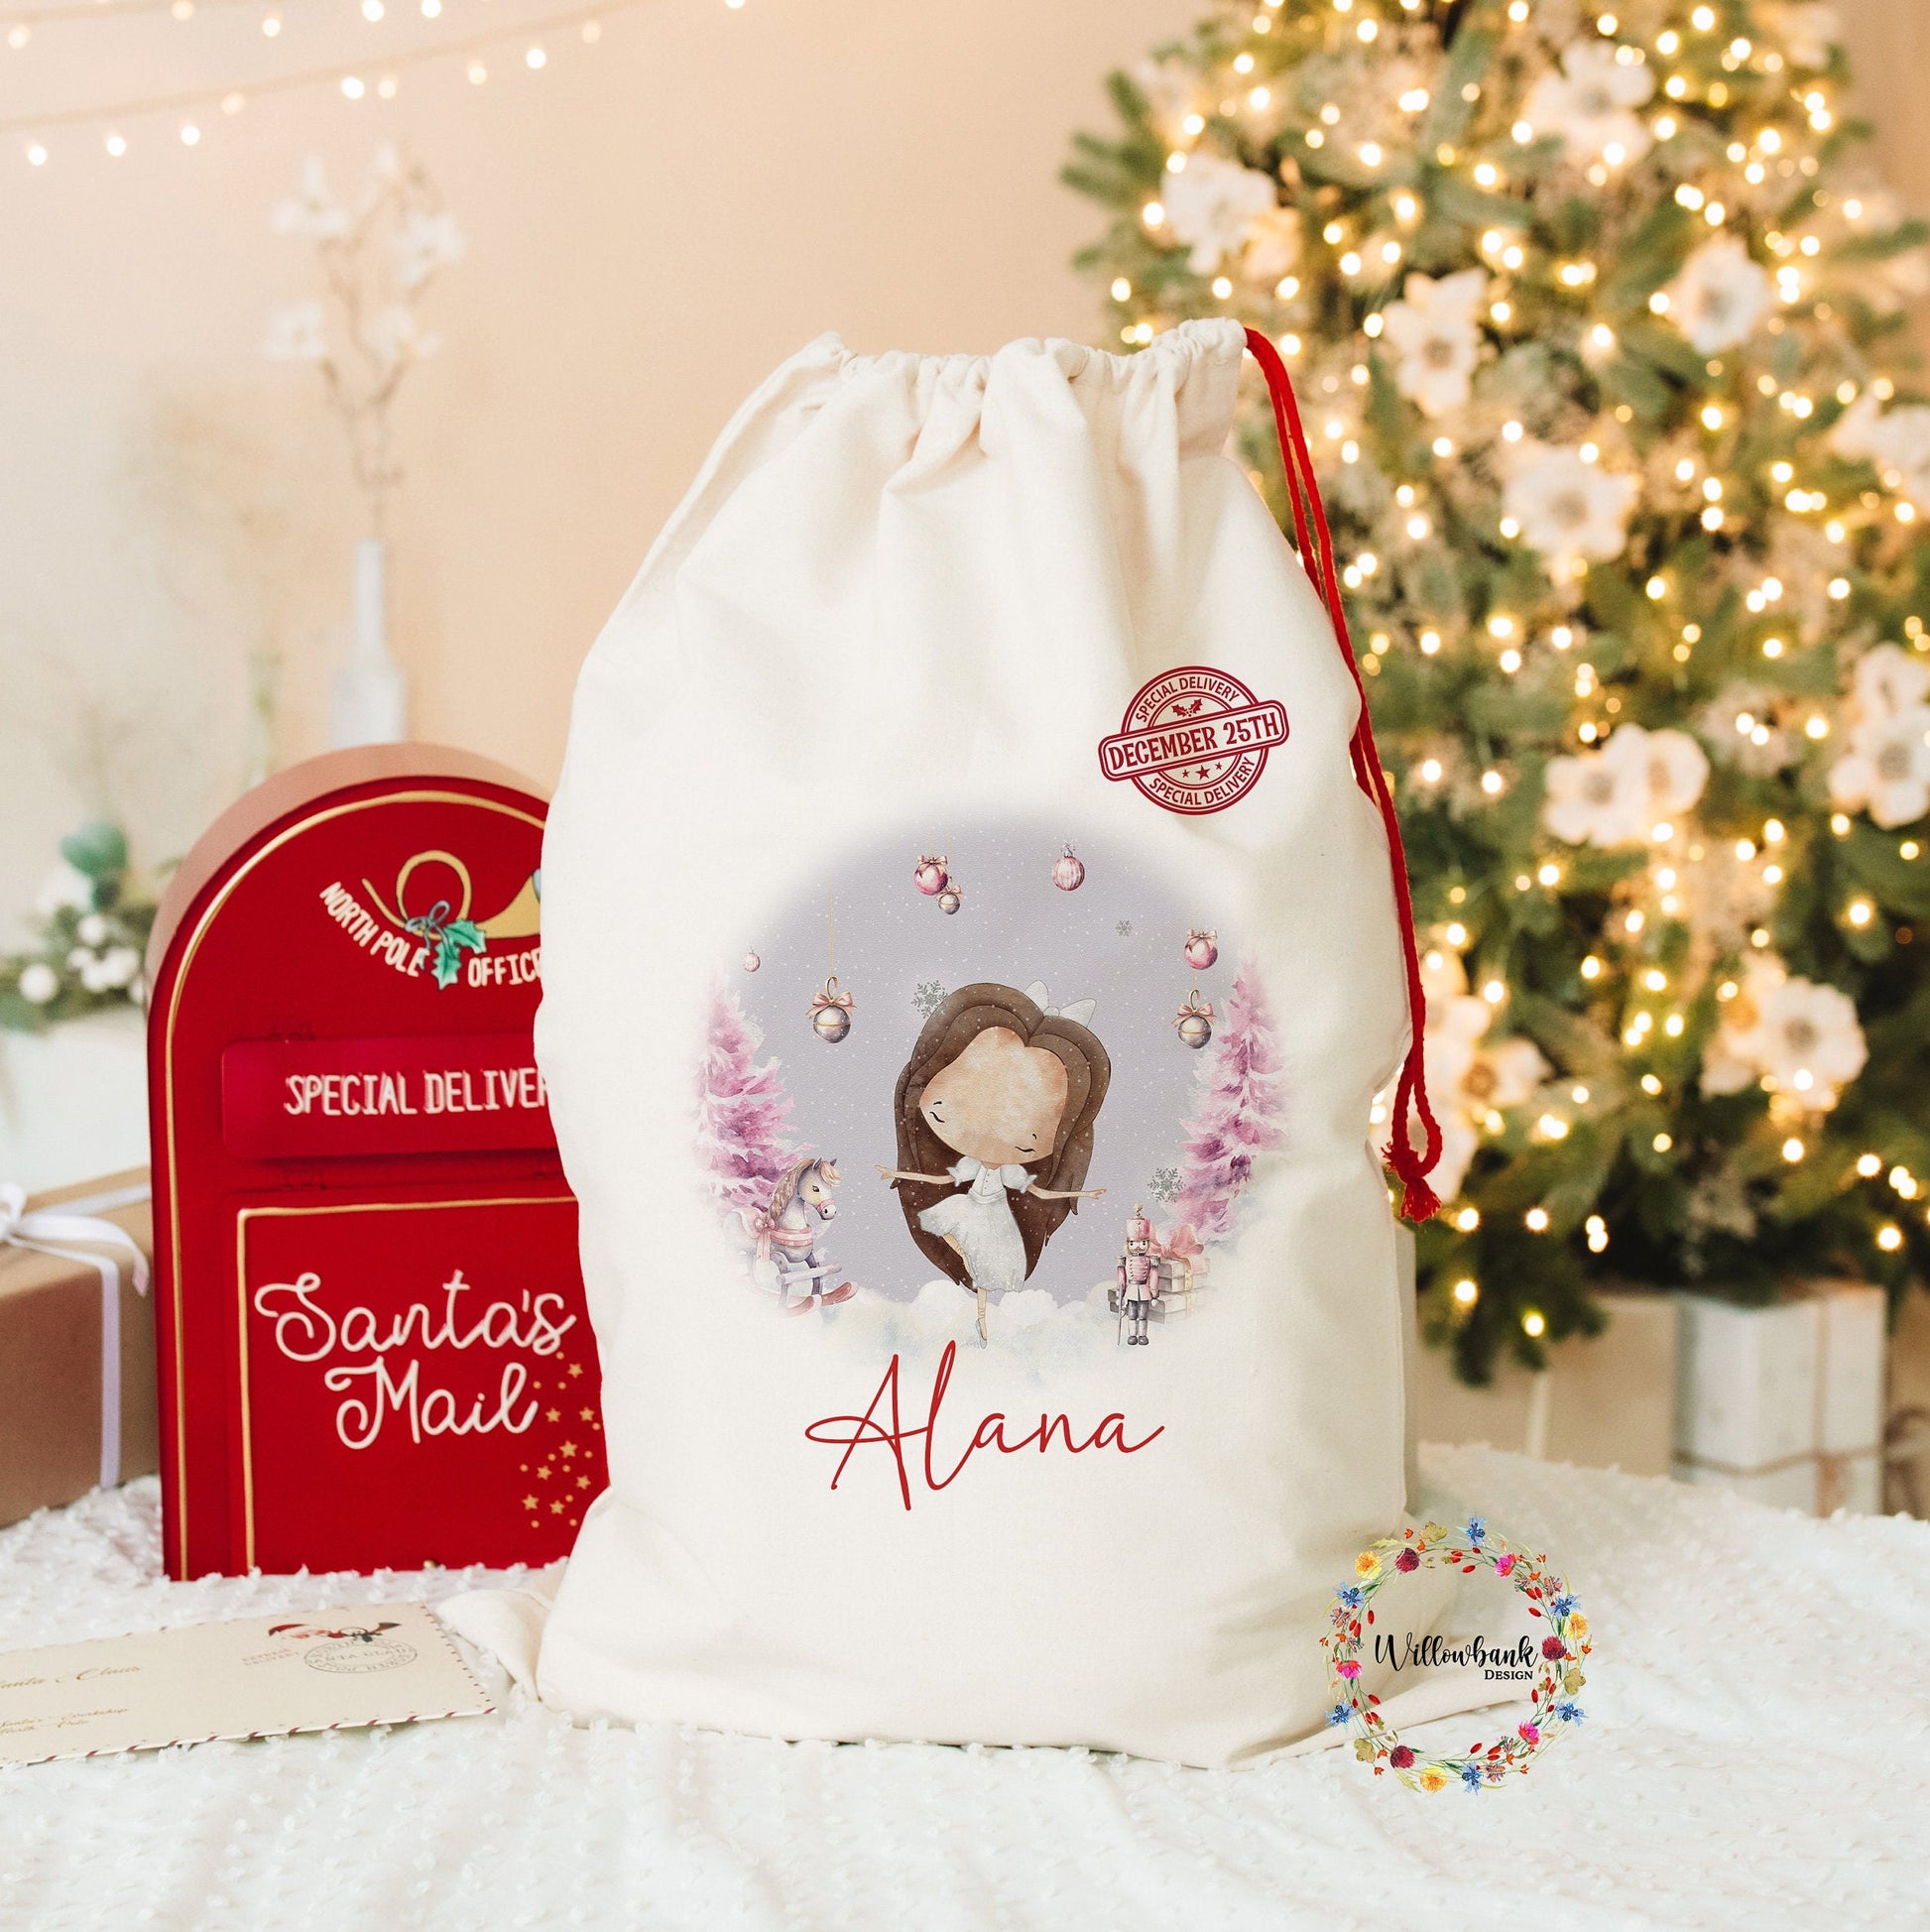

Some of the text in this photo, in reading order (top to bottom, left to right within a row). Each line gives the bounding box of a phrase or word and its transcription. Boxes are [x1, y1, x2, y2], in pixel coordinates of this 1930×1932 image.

[1136, 676, 1240, 722] SPECIAL DELIVERY
[1108, 712, 1279, 771] DECEMBER 25TH
[1148, 757, 1256, 805] SPECIAL DELIVERY
[319, 882, 379, 947] NORTH
[369, 930, 430, 978] POLE
[284, 1071, 418, 1116] SPECIAL
[254, 1269, 576, 1362] Santa's
[324, 1356, 539, 1450] Mail
[804, 1340, 1165, 1510] Alana
